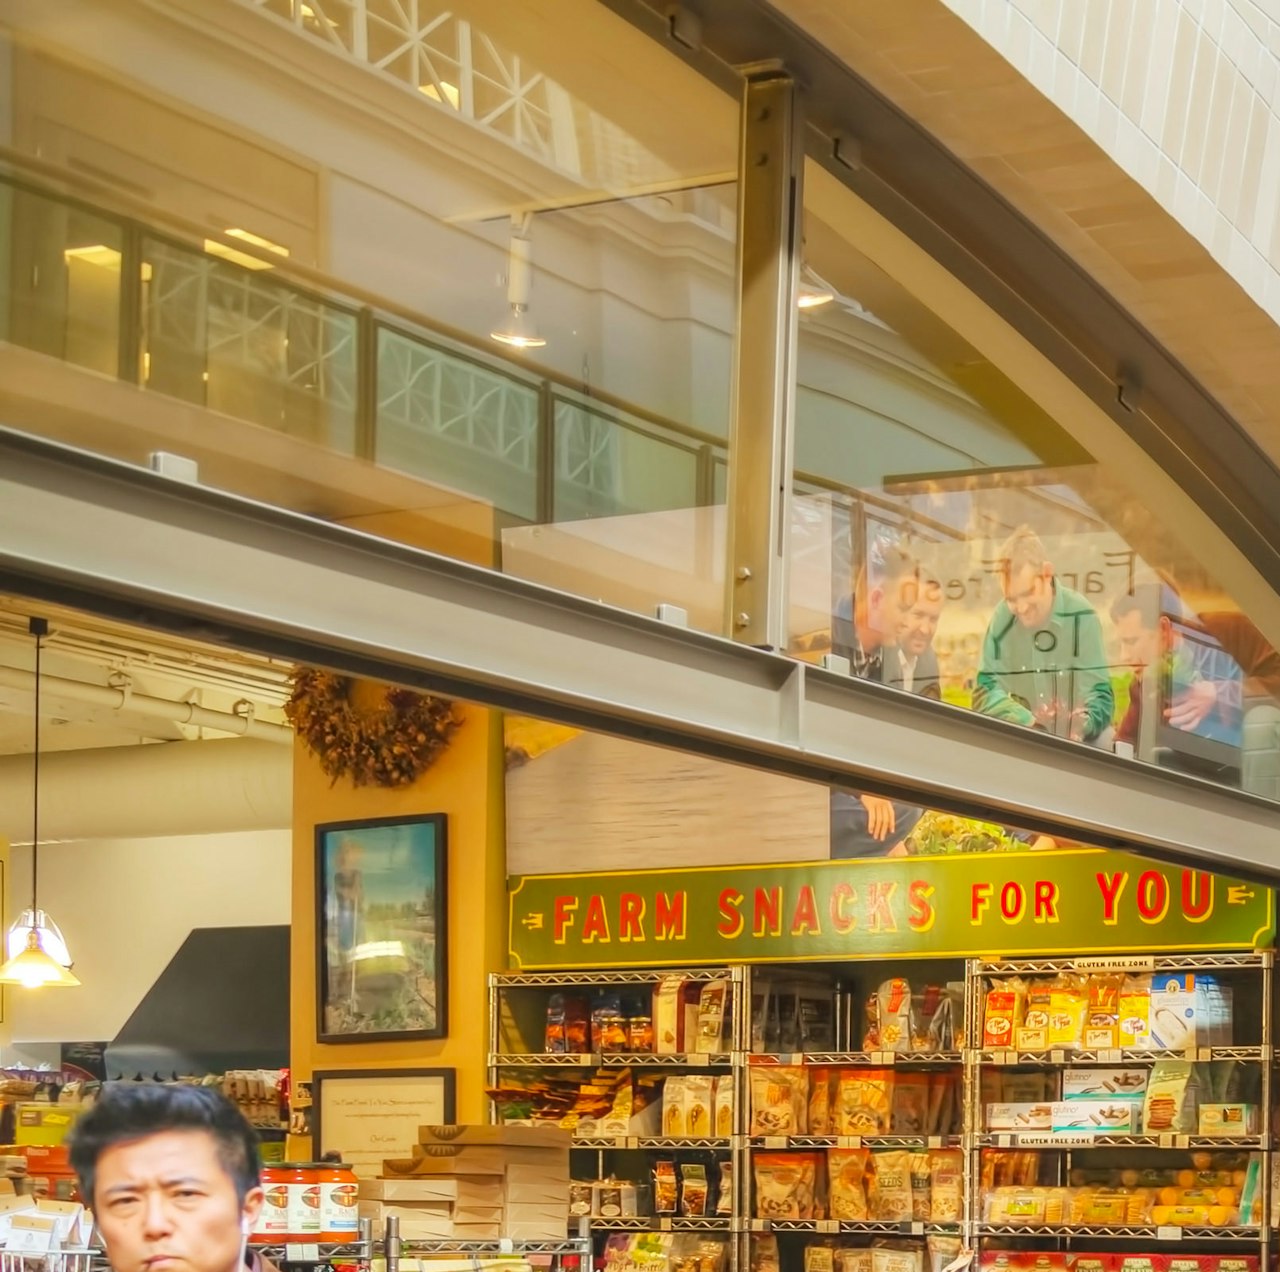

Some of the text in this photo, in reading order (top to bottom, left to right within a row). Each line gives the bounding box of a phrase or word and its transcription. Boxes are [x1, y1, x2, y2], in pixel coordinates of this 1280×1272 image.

[554, 868, 1214, 945] FARM SNACKS FOR YOU
[1077, 959, 1149, 969] GLUTEN FREE ZONE
[1070, 1137, 1091, 1145] ZONE
